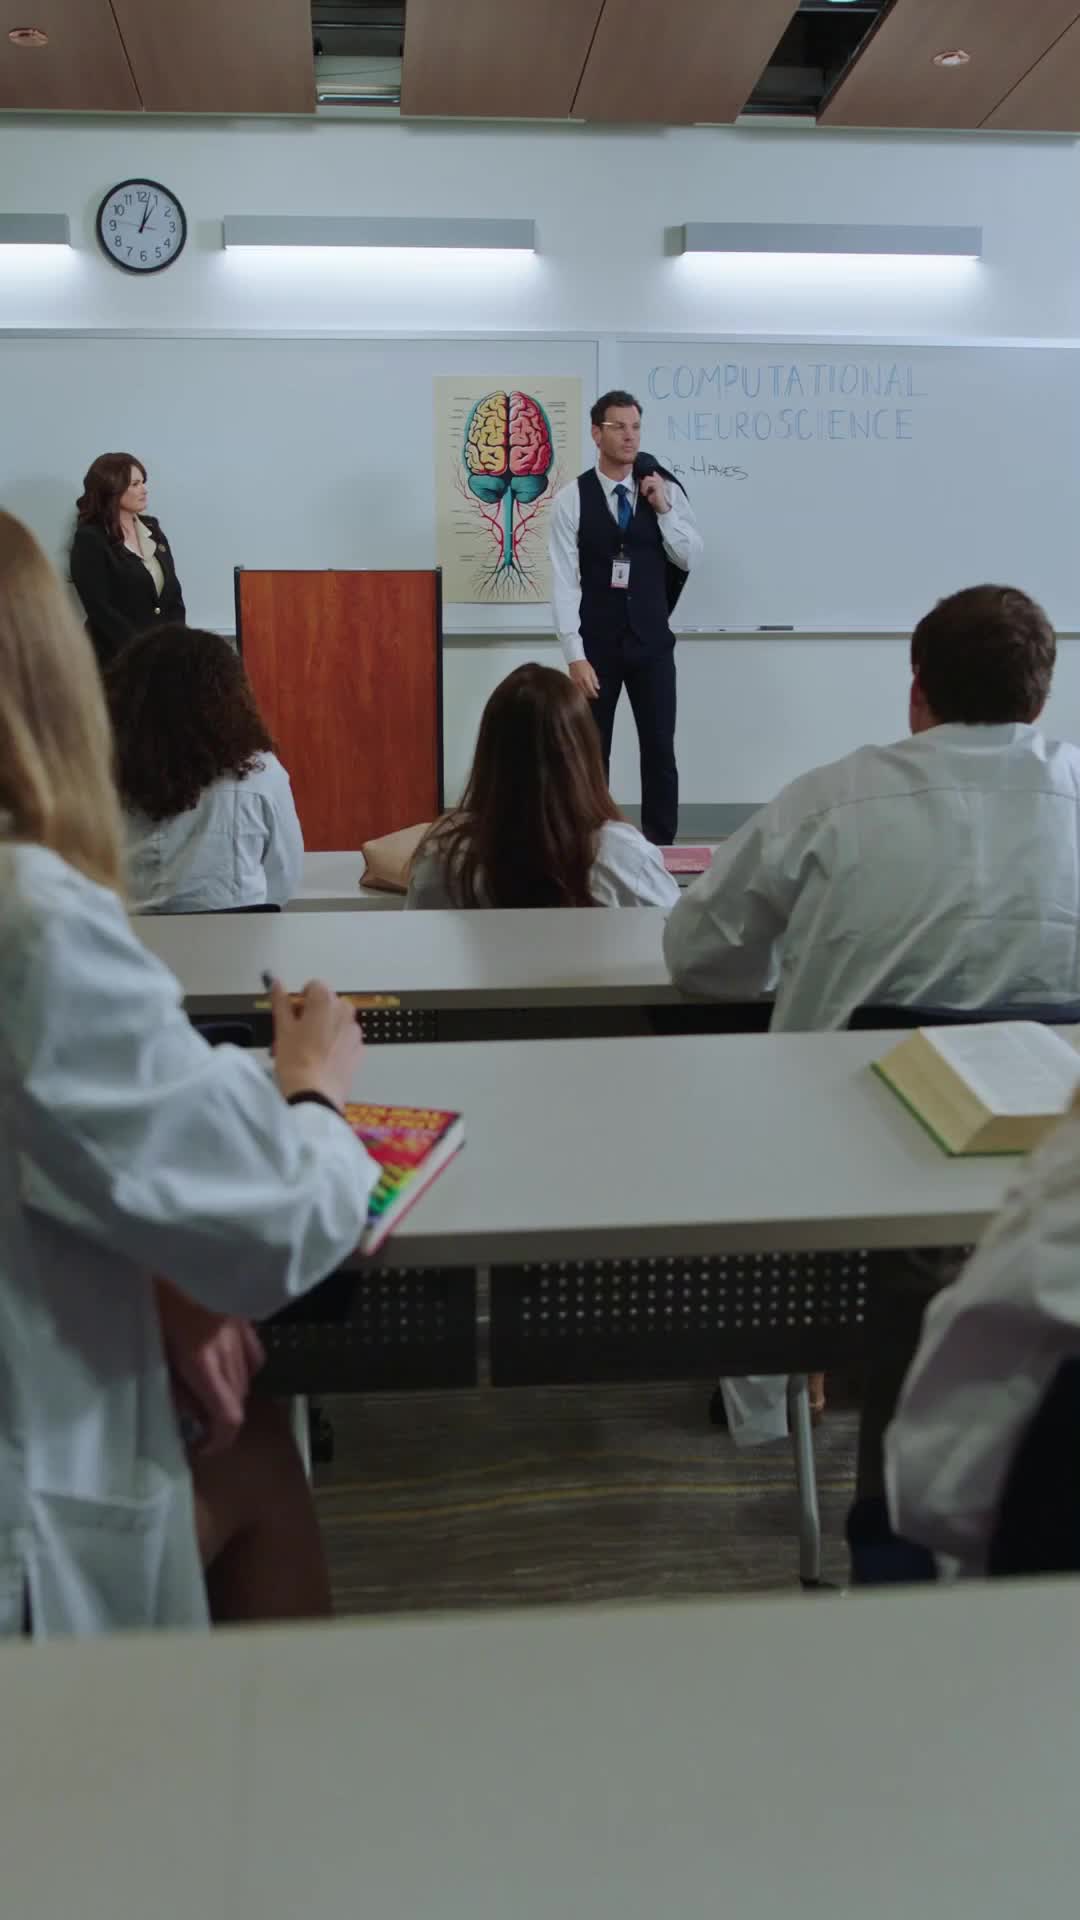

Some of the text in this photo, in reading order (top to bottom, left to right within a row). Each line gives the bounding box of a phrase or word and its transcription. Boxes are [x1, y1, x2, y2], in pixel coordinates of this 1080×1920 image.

[124, 194, 133, 206] 11
[136, 191, 148, 203] 12
[153, 194, 159, 206] 1
[114, 204, 125, 216] 10
[164, 206, 171, 218] 2
[109, 219, 117, 231] 9
[169, 221, 176, 233] 3
[114, 235, 122, 247] 8
[164, 238, 171, 249] 4
[126, 246, 133, 257] 7
[140, 250, 147, 262] 6
[155, 247, 162, 259] 5
[648, 363, 928, 400] COMPUTATIONAL
[667, 407, 913, 441] NEUROSCIENCE
